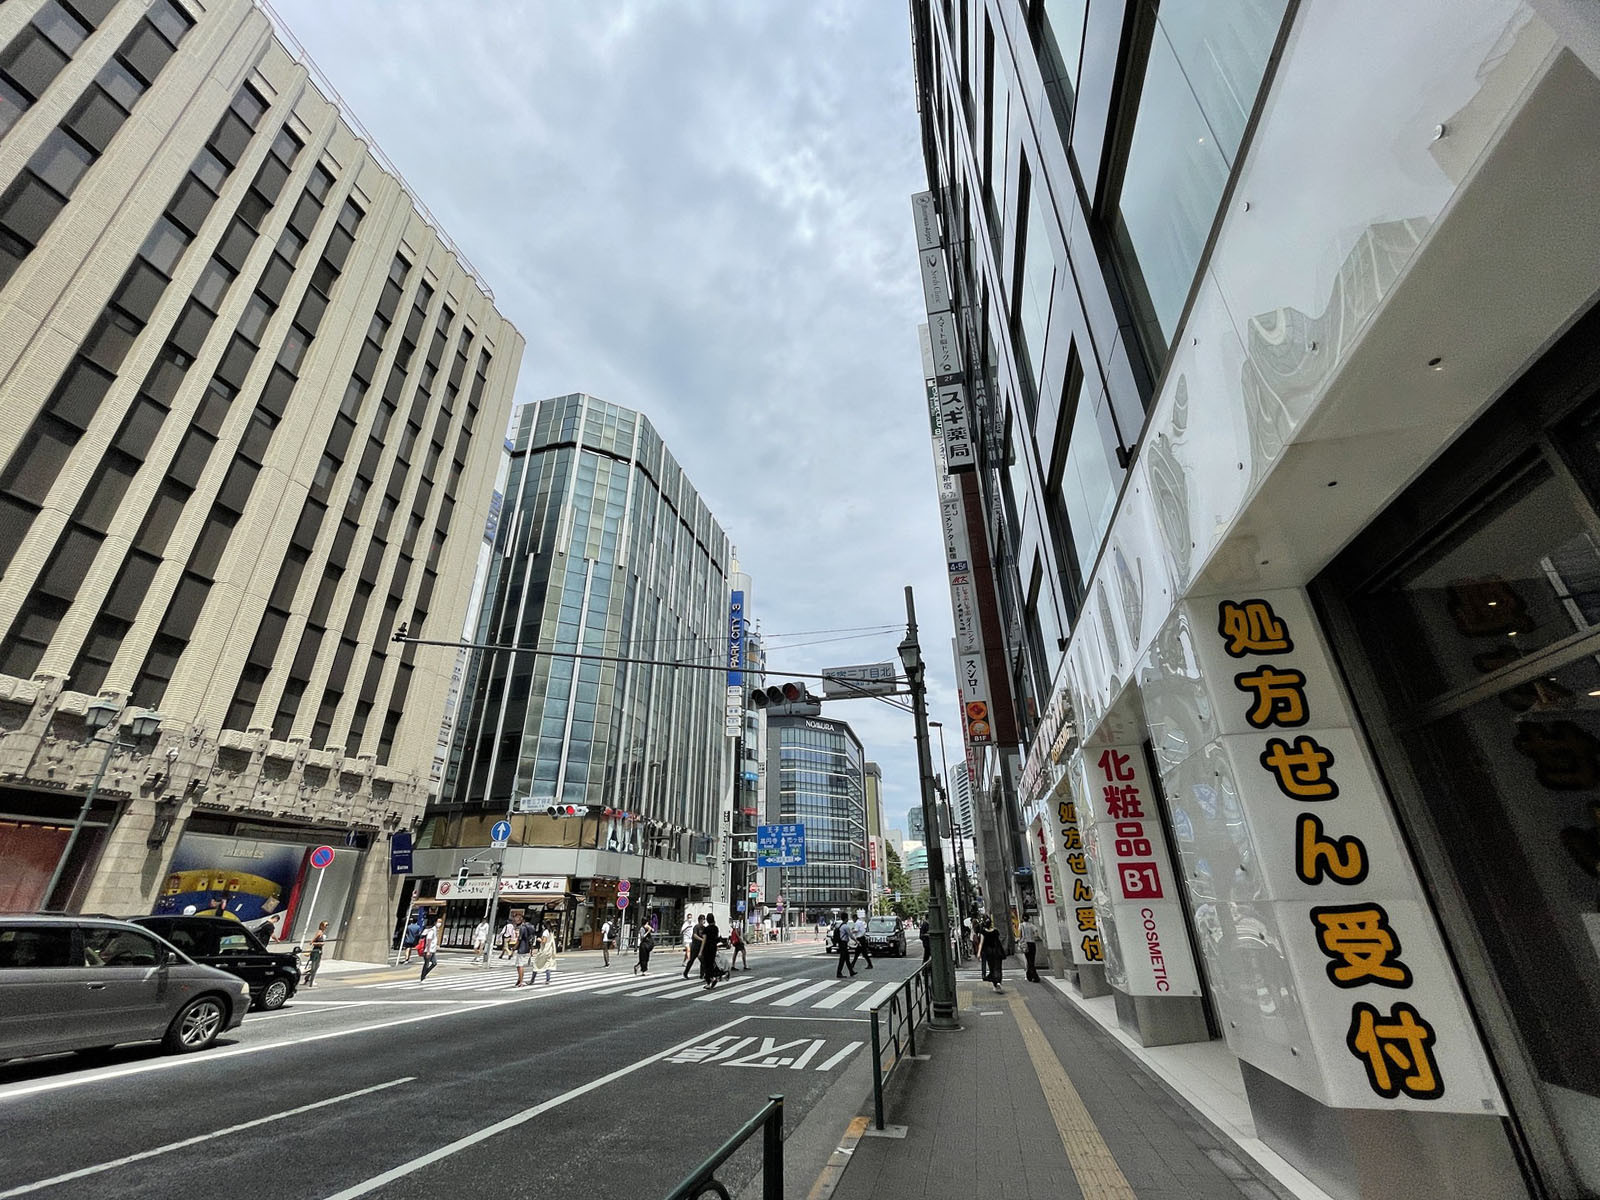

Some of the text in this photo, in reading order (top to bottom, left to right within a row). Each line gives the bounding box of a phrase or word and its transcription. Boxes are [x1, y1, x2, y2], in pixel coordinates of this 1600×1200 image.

[942, 391, 969, 459] スギ薬局
[730, 603, 741, 668] PARK CITY 3
[966, 661, 977, 695] スシロー
[1098, 749, 1152, 857] 化粧品
[1124, 867, 1159, 893] B1
[1218, 598, 1445, 1100] 処方せん受付
[1141, 907, 1170, 992] COSMETIC
[662, 1035, 865, 1071] バス停
